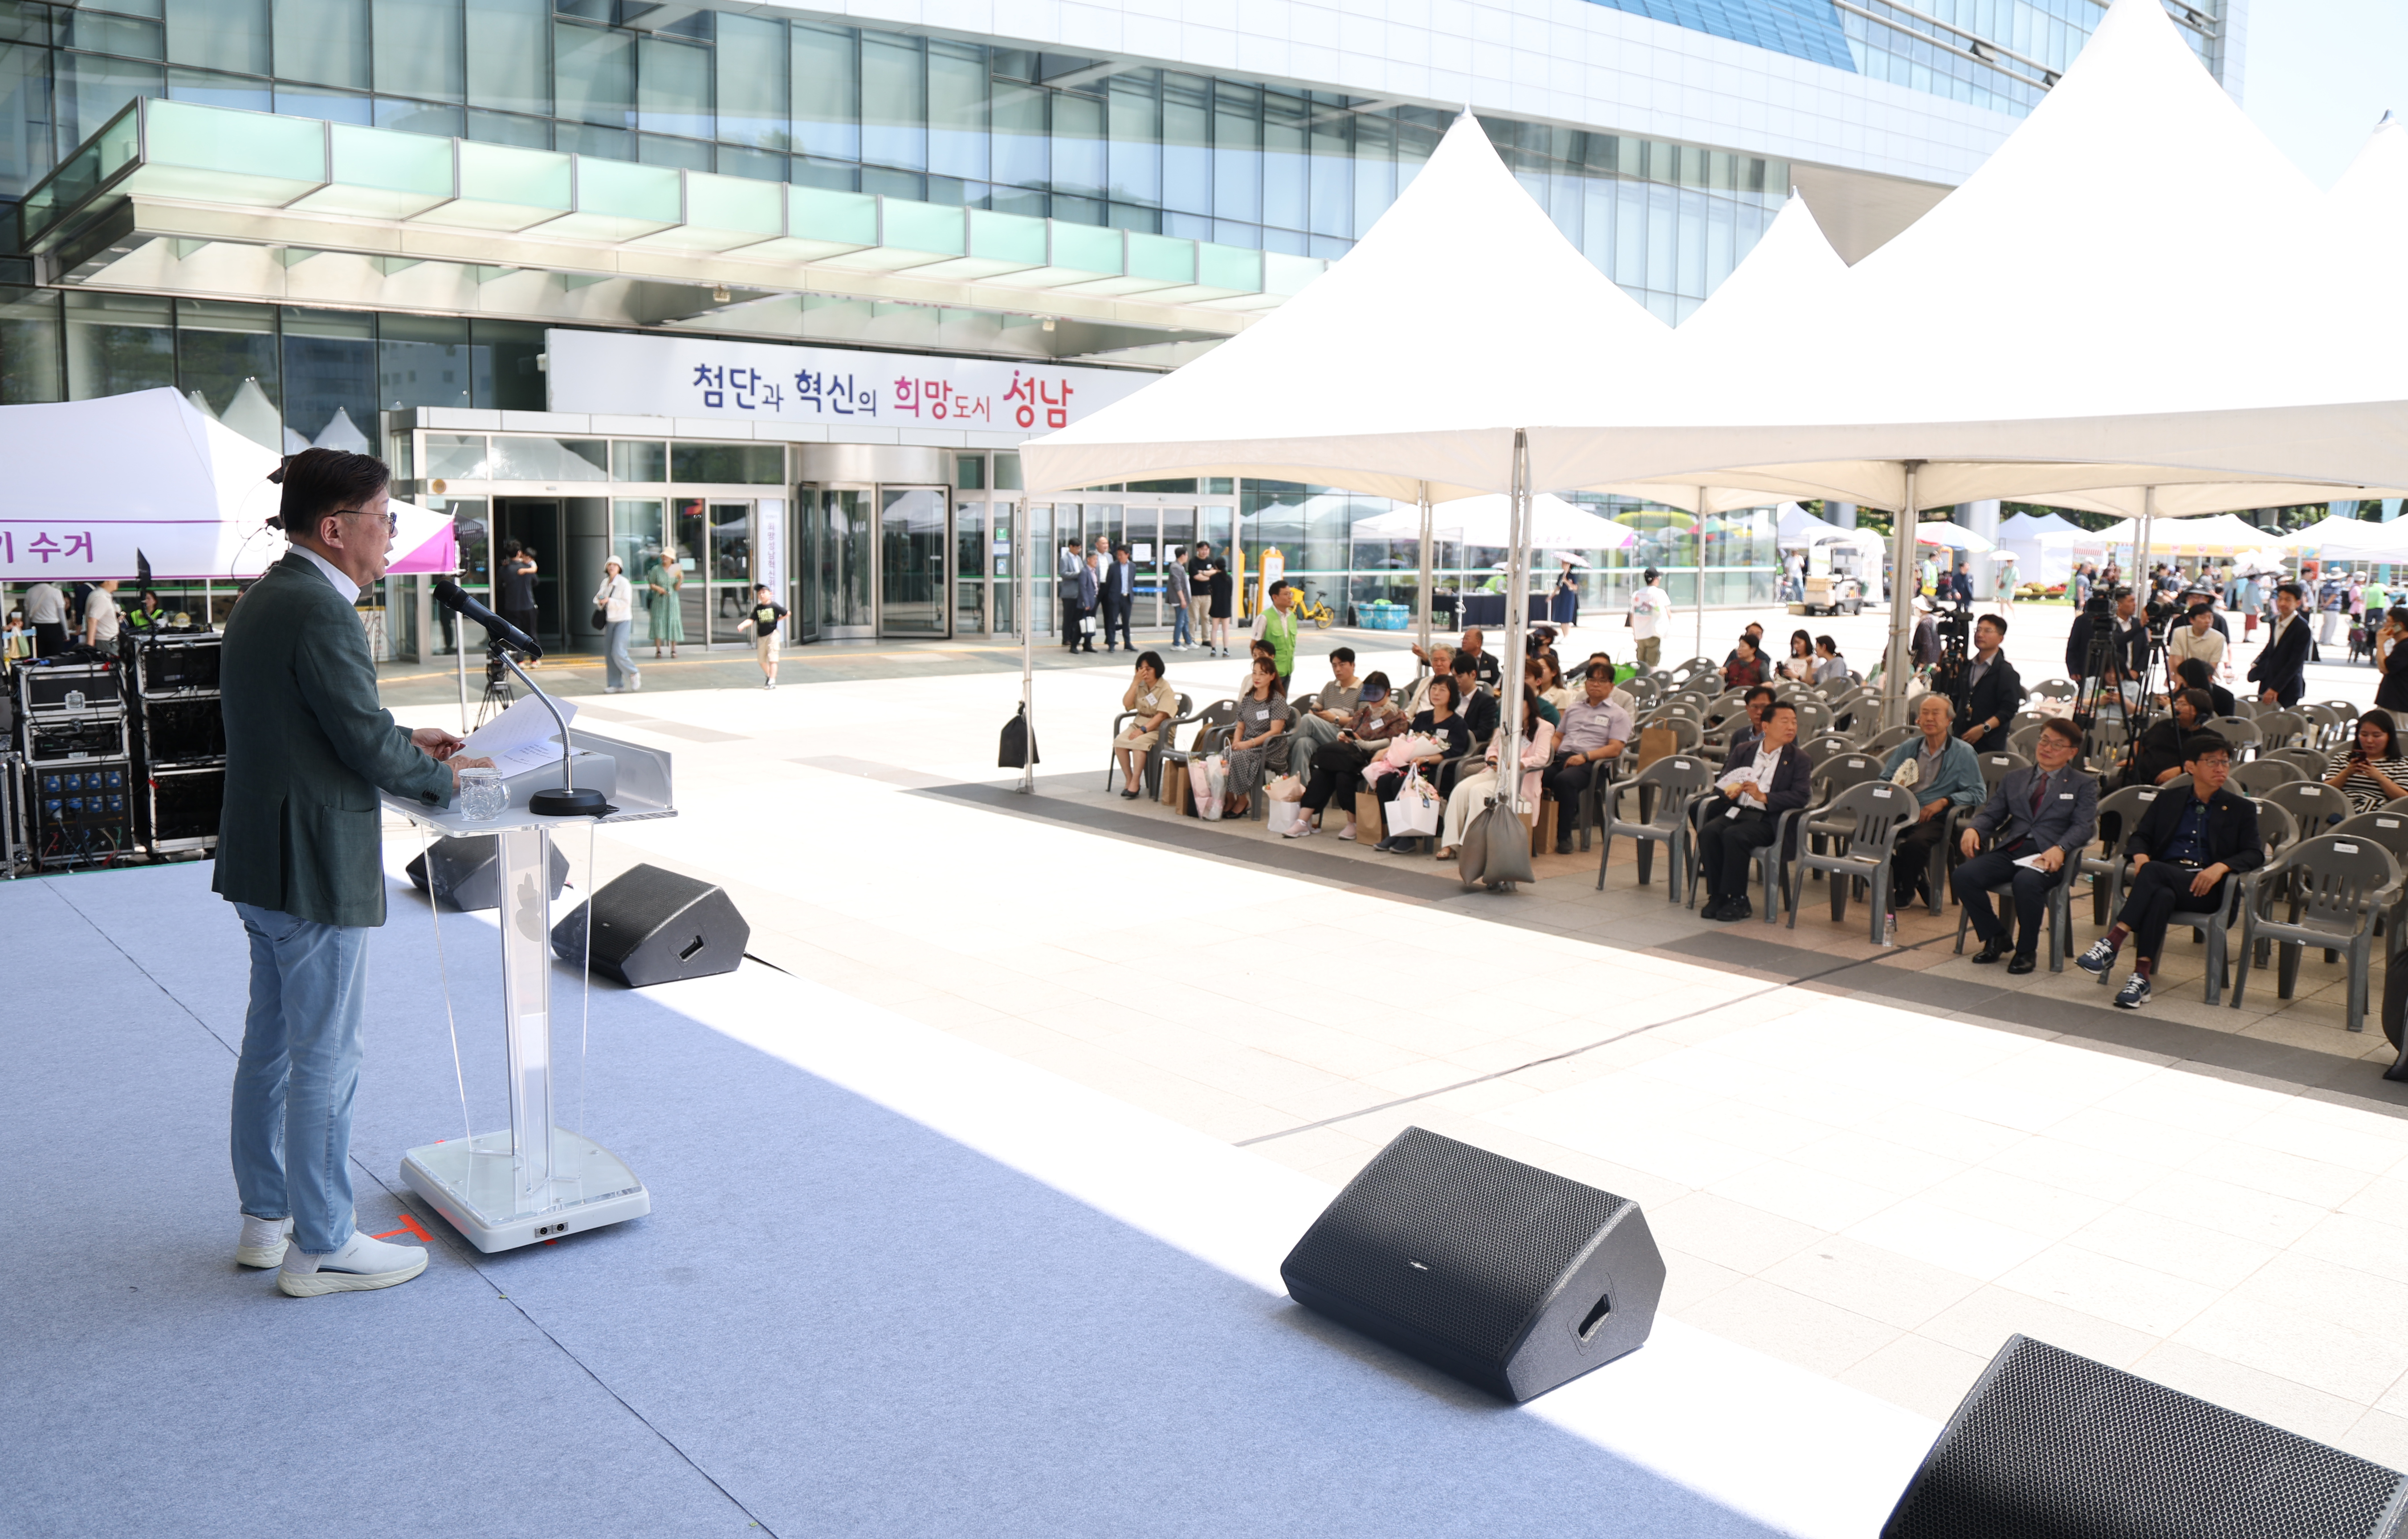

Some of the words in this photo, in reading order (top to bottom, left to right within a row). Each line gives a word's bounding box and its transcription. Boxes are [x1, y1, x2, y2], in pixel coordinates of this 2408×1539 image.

[693, 364, 783, 411] 첨단과
[795, 369, 876, 416] 혁신의
[894, 376, 990, 422] 희망도시
[1003, 370, 1074, 428] 성남
[28, 531, 93, 563] 수거
